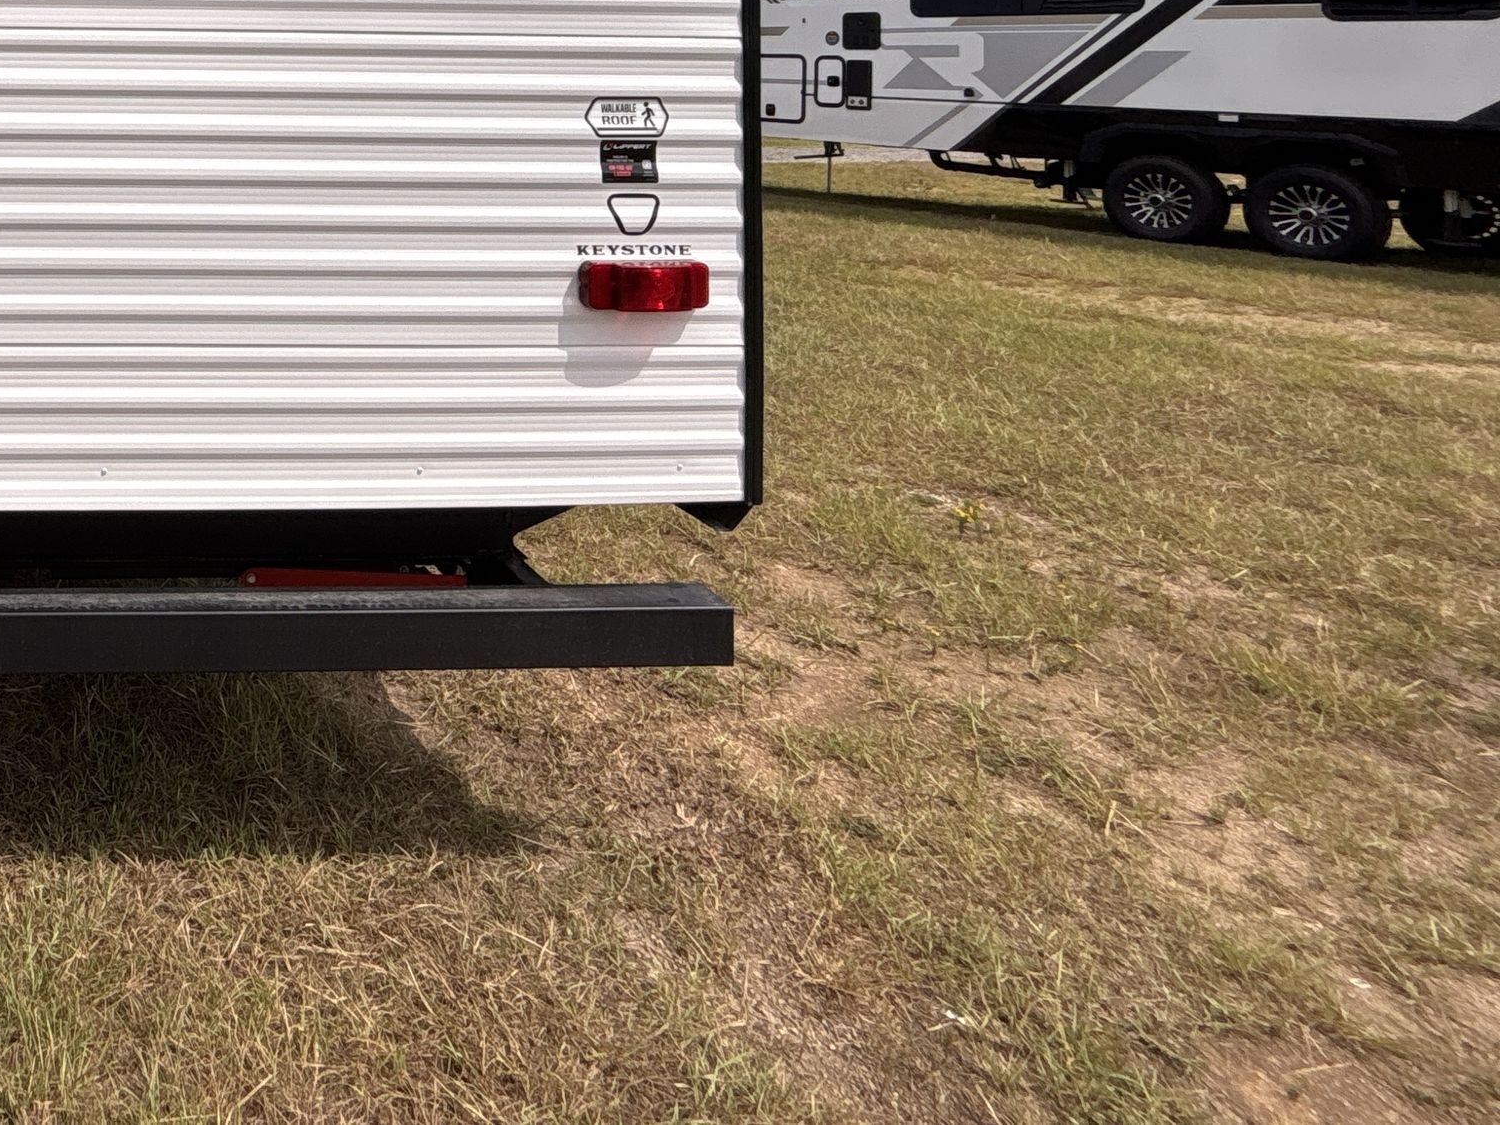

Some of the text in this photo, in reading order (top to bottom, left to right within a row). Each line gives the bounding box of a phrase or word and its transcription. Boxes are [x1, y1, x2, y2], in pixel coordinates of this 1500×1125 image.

[601, 103, 636, 113] WALKABLE
[602, 115, 637, 125] ROOF
[576, 244, 692, 256] KEYSTONE
